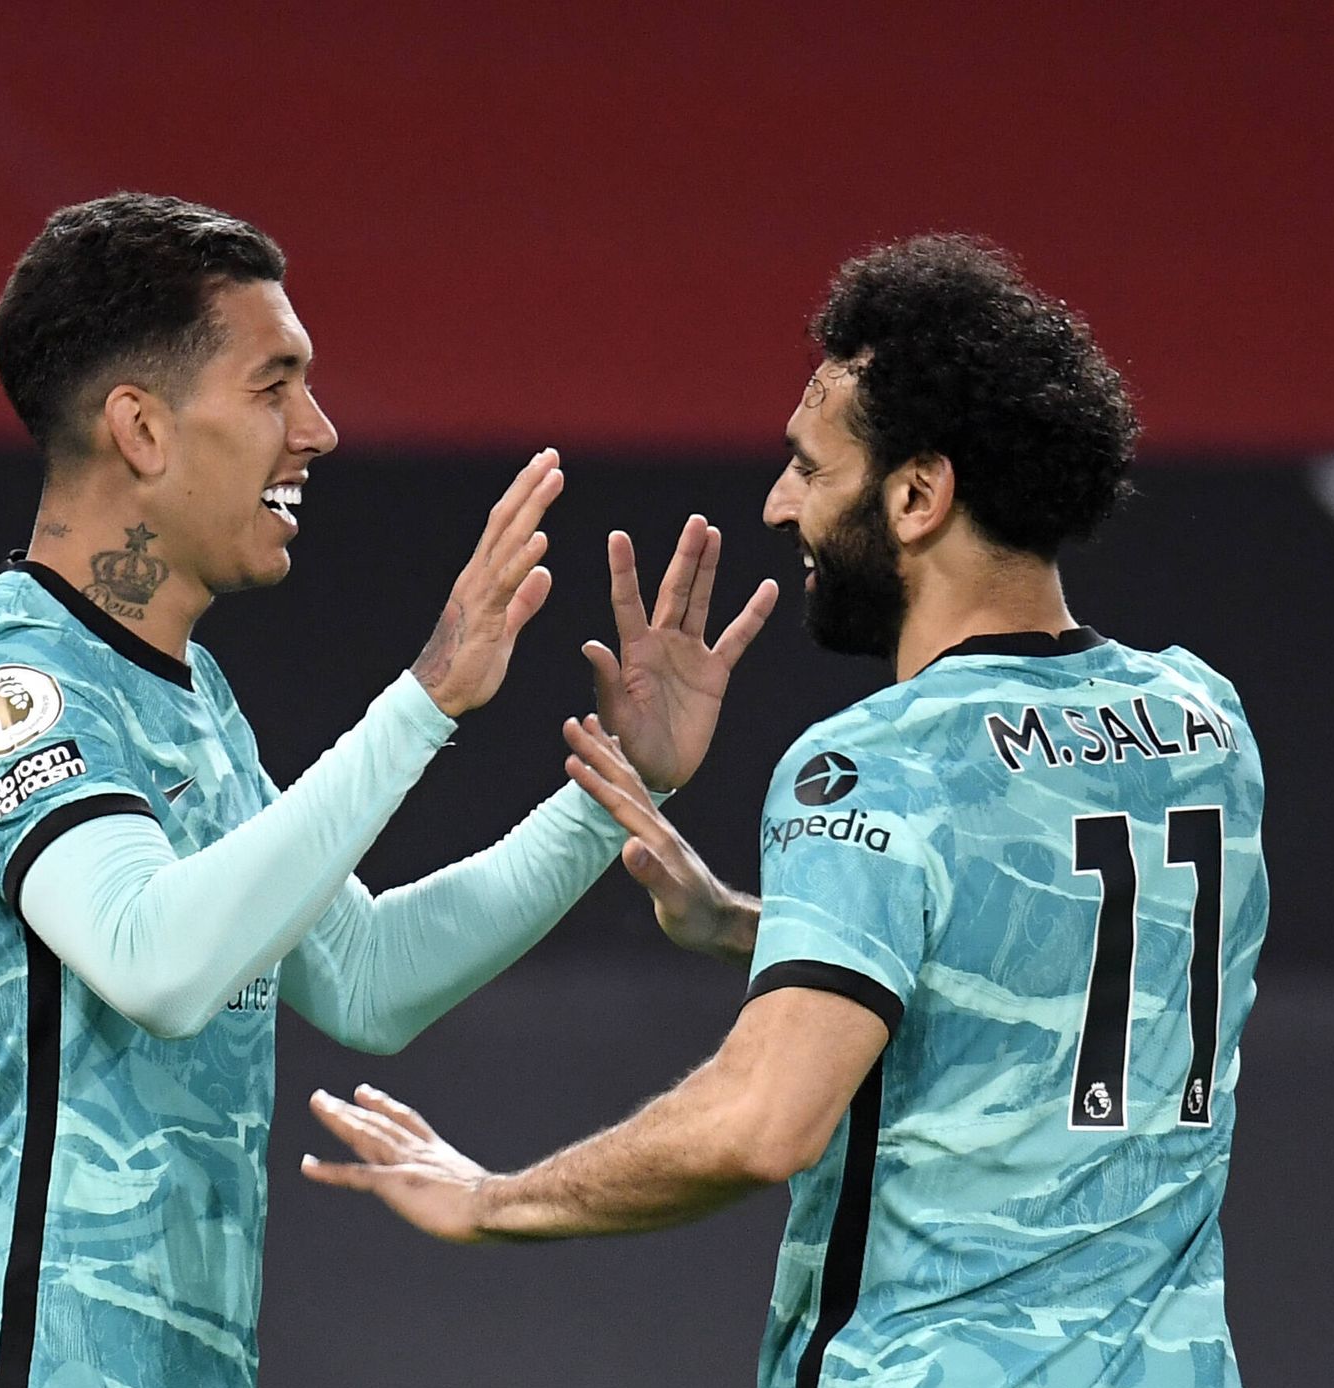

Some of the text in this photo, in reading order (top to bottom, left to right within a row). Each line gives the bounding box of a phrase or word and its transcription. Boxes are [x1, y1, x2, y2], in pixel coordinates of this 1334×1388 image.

[13, 745, 72, 784] room
[18, 757, 87, 801] racism
[1068, 804, 1224, 1131] 11
